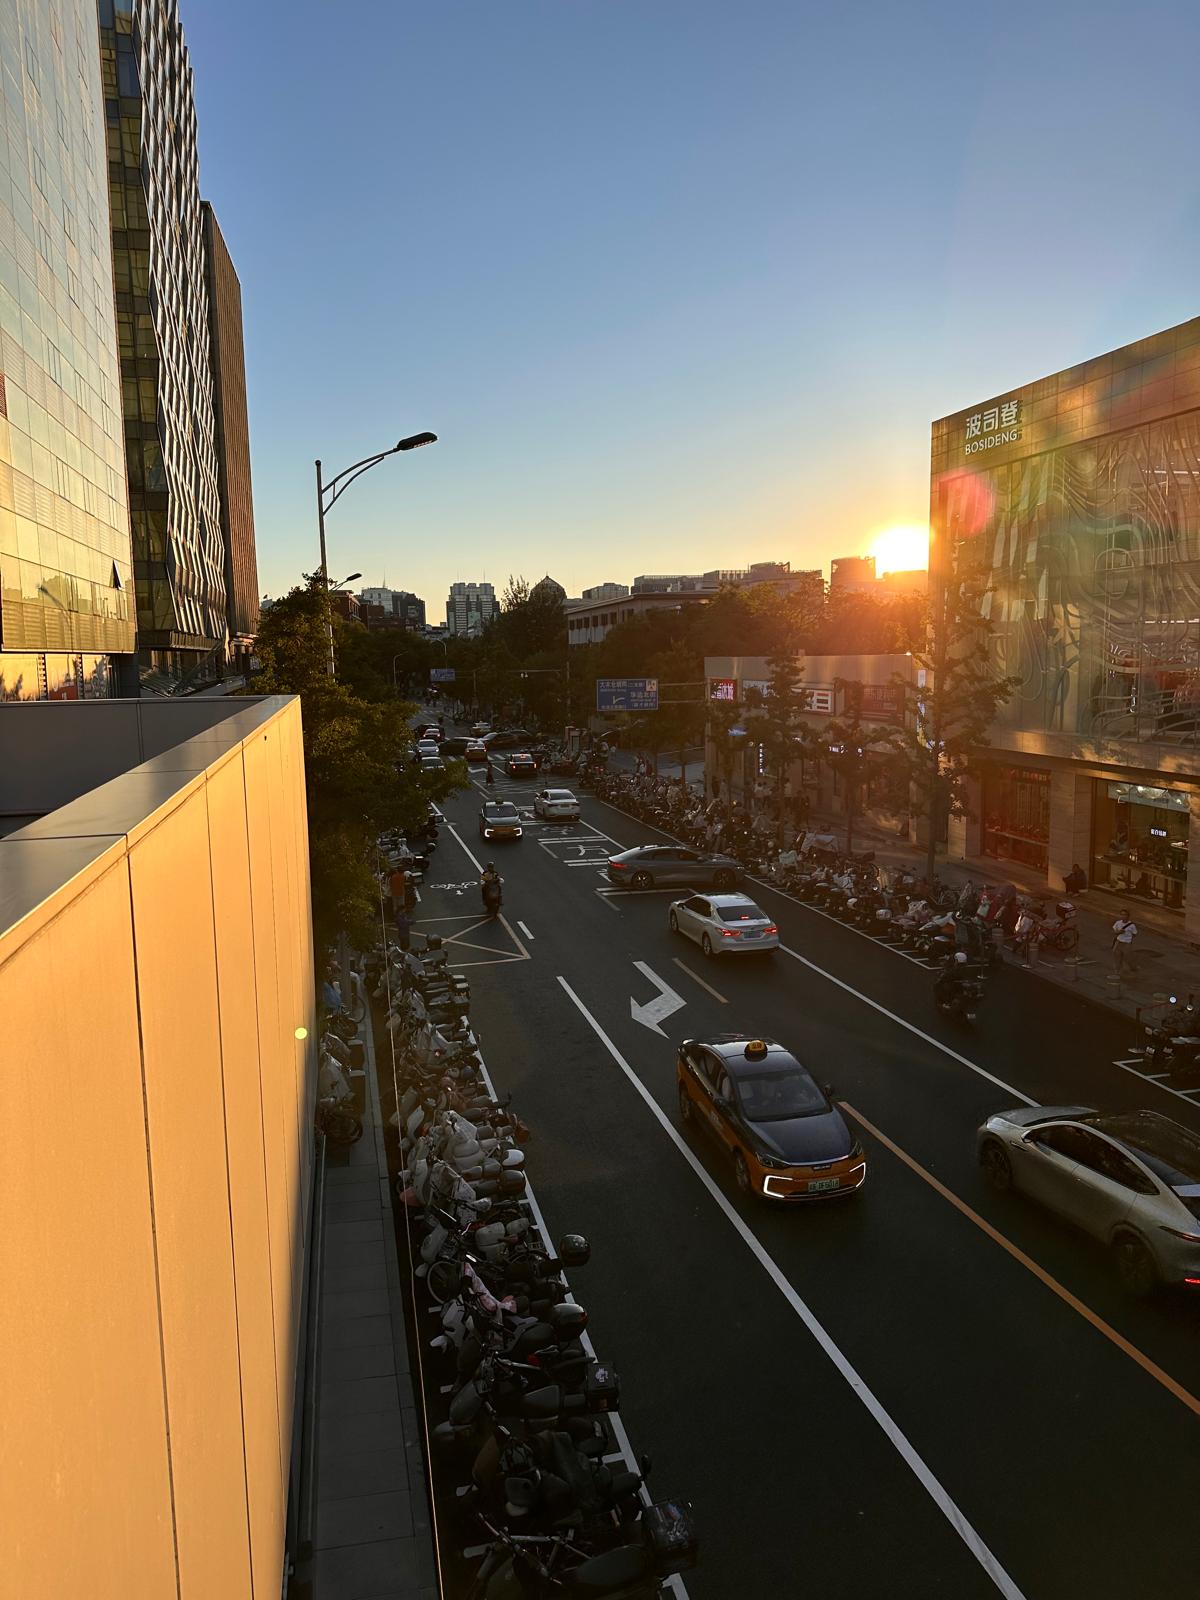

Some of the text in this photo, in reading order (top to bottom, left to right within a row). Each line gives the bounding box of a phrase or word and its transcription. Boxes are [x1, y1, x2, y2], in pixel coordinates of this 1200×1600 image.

[965, 400, 1018, 440] 波司登
[965, 429, 1018, 455] BOSIDENG
